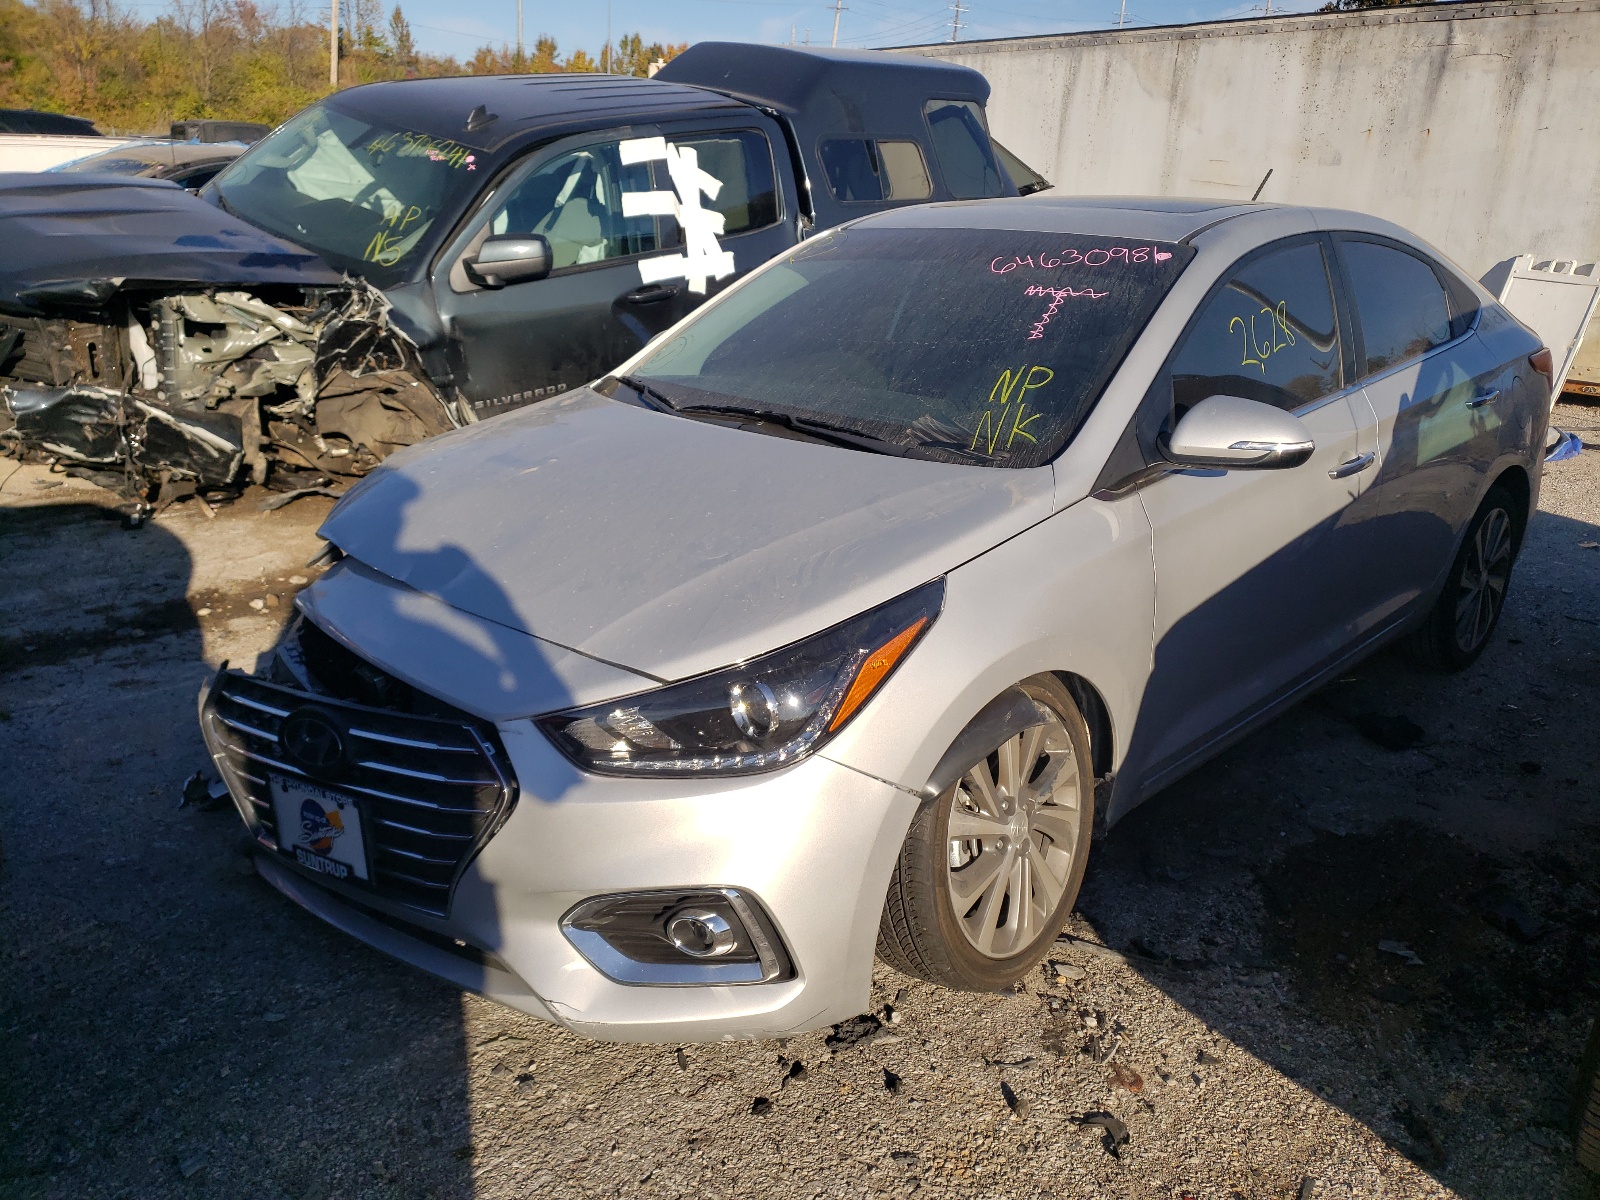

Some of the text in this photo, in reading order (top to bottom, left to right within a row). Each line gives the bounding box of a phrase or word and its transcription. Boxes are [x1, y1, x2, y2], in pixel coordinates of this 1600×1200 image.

[363, 229, 403, 267] NS
[991, 245, 1160, 275] 64630981
[474, 383, 568, 410] SILVERADO
[989, 364, 1055, 405] NP
[970, 402, 1044, 455] NK
[296, 848, 348, 879] SUNTRUP
